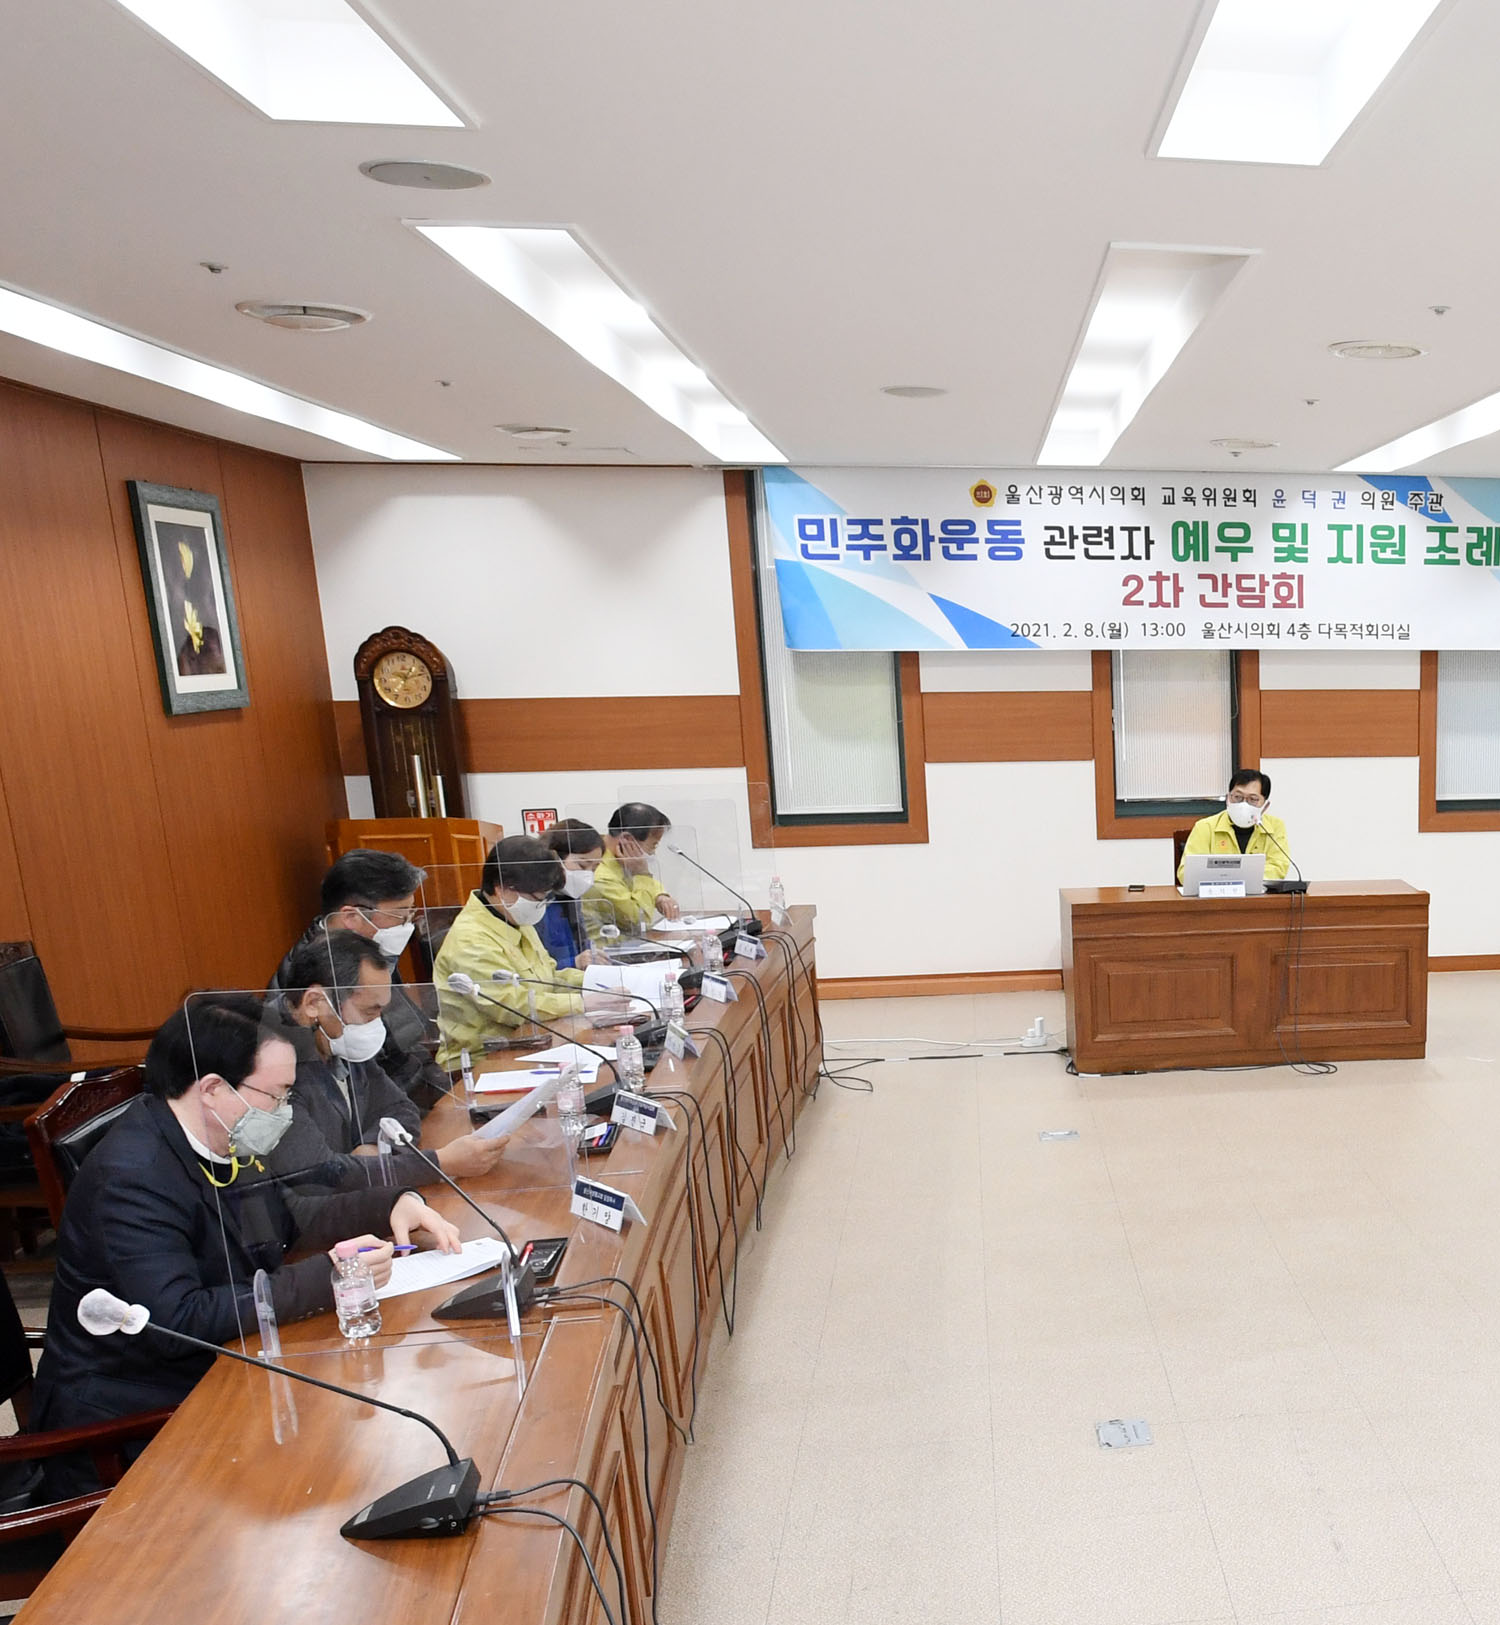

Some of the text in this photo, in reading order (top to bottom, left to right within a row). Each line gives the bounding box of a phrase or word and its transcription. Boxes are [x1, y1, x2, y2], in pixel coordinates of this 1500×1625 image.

[1004, 484, 1147, 506] 울산광역시의회
[1161, 486, 1257, 508] 교육위원회
[1360, 490, 1395, 511] 의원
[1407, 491, 1444, 513] 주관
[797, 515, 1025, 562] 민주화운동
[1043, 524, 1156, 561] 관련자
[1171, 520, 1254, 563] 예우
[1271, 522, 1309, 564] 및
[1327, 523, 1406, 565] 지원
[1121, 571, 1305, 609] 2차 간담회
[1010, 622, 1057, 639] 2021.
[1062, 622, 1078, 639] 2.
[1140, 622, 1186, 638] 13:00
[1201, 621, 1281, 640] 울산시의회
[1286, 622, 1312, 640] 4층
[1317, 622, 1411, 641] 다목적회의실
